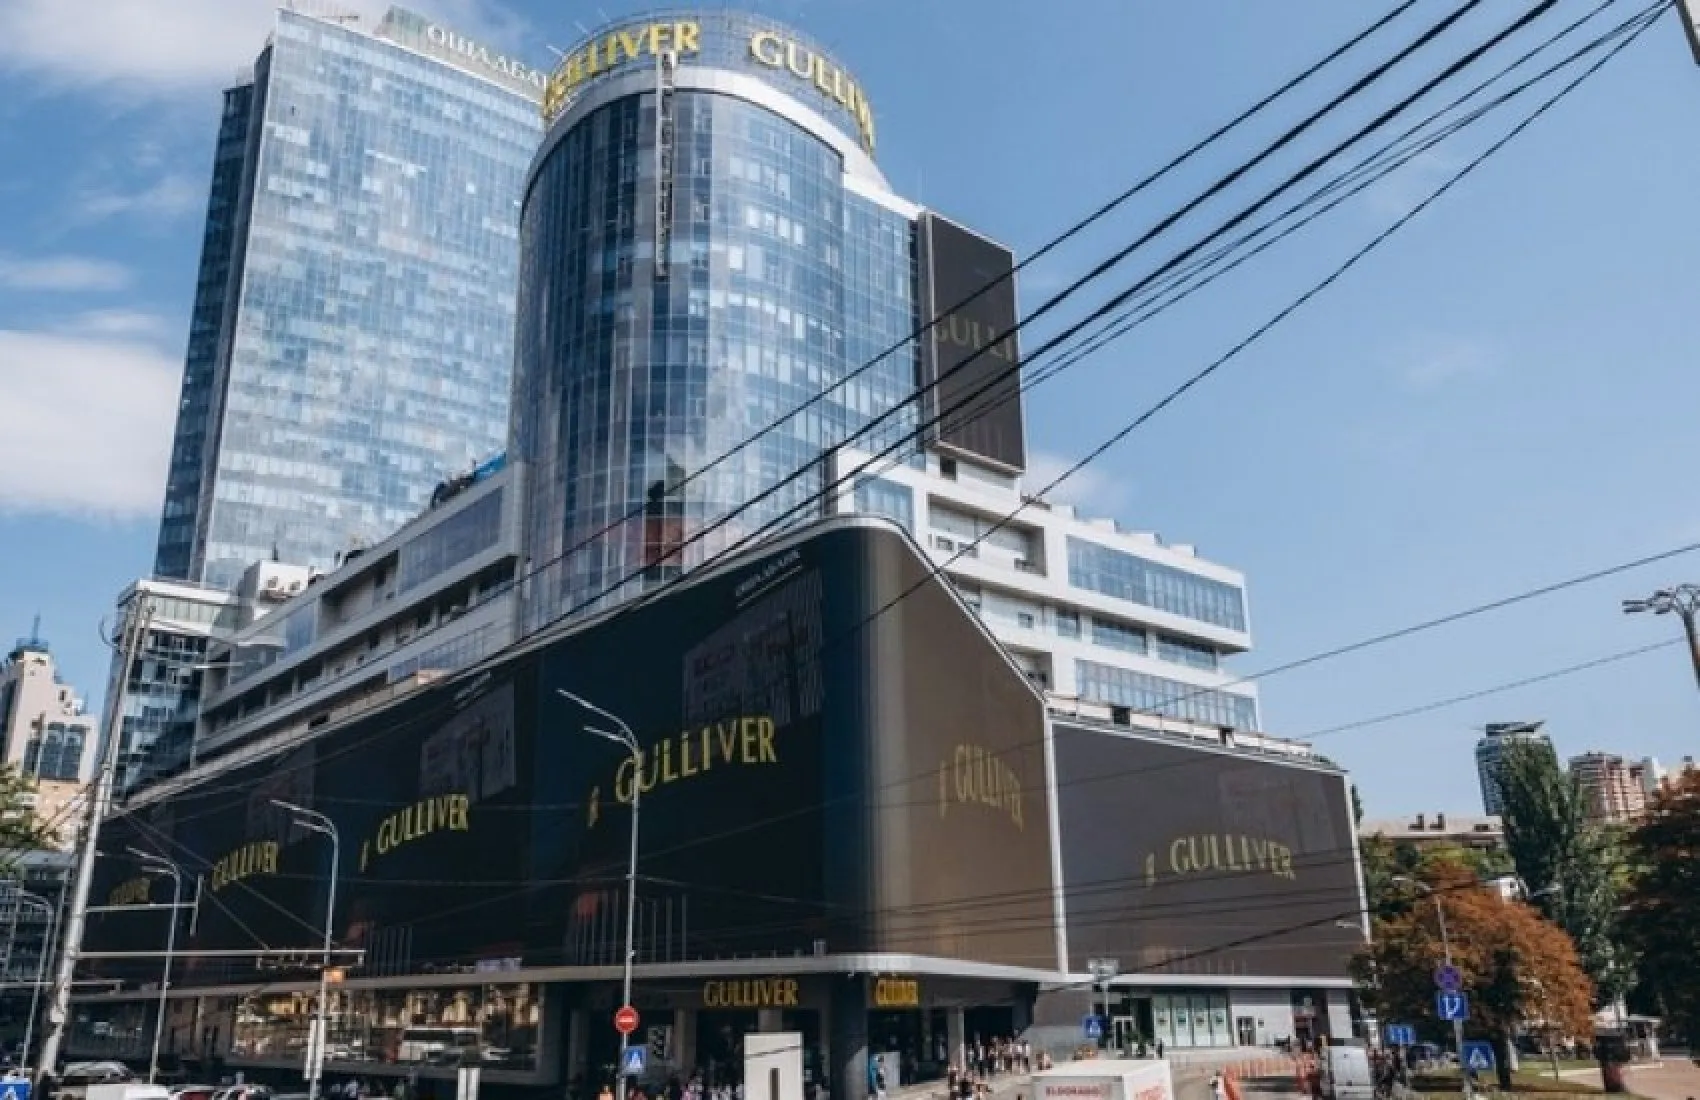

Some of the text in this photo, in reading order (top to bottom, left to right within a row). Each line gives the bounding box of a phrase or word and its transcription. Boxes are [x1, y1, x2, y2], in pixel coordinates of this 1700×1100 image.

[615, 718, 777, 802] GULLIVER
[378, 794, 468, 854] GULLIVER
[1169, 834, 1296, 880] GULLIVER
[704, 980, 798, 1006] GULLIVER
